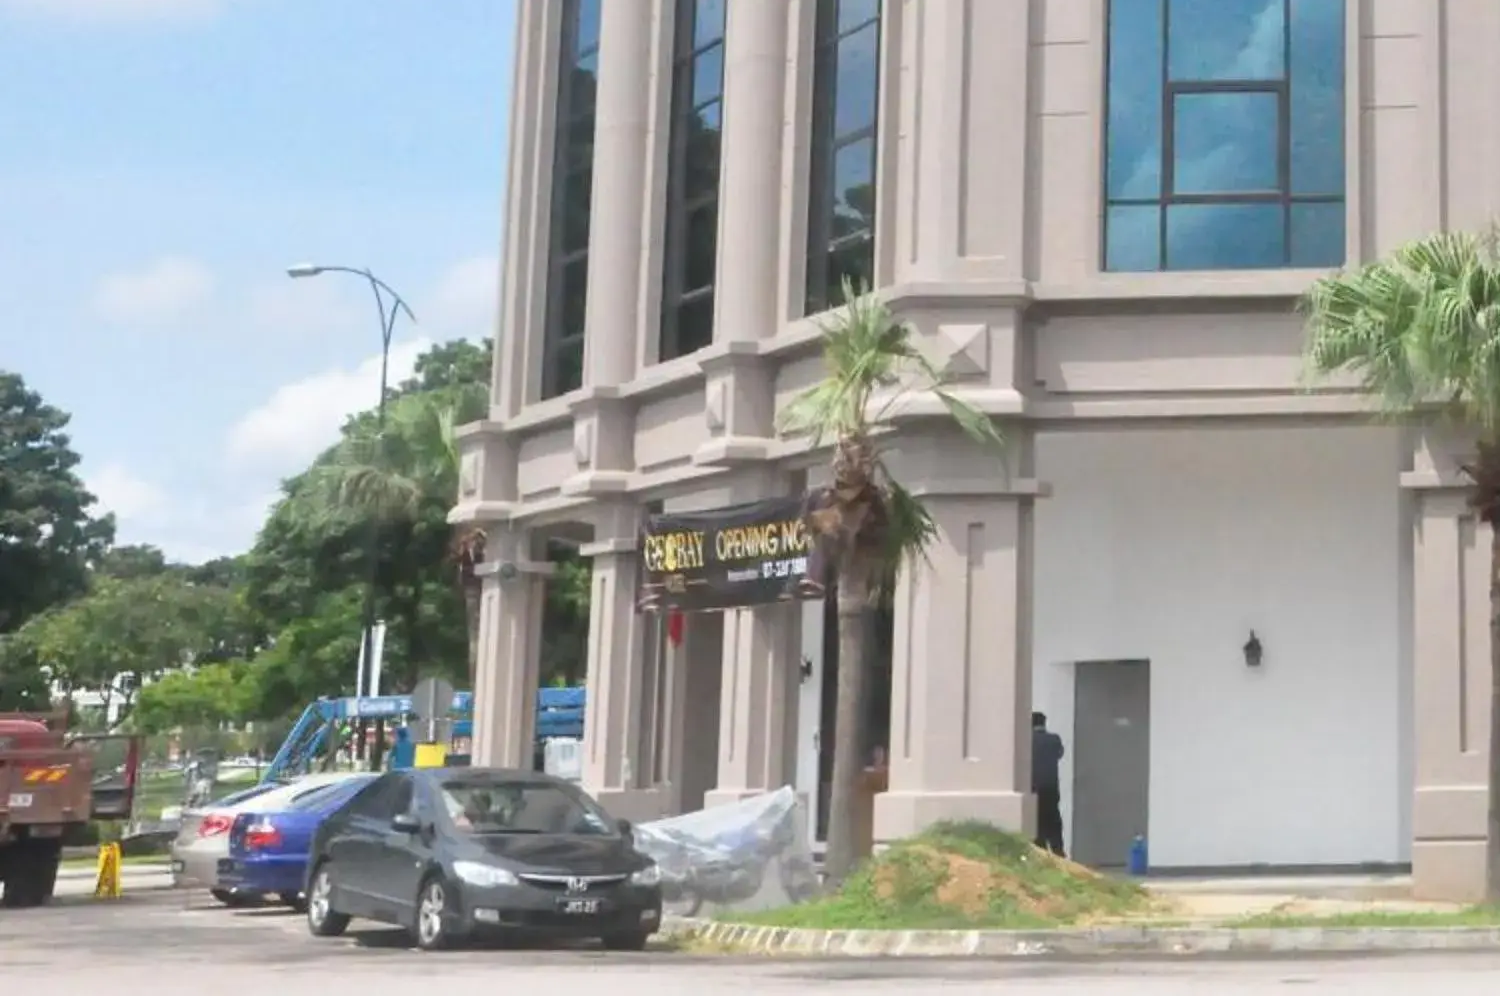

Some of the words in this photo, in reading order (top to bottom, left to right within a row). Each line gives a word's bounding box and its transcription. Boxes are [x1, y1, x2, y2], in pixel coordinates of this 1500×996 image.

[644, 531, 705, 571] GEOBAY
[715, 522, 778, 562] OPENING
[780, 517, 815, 553] NO
